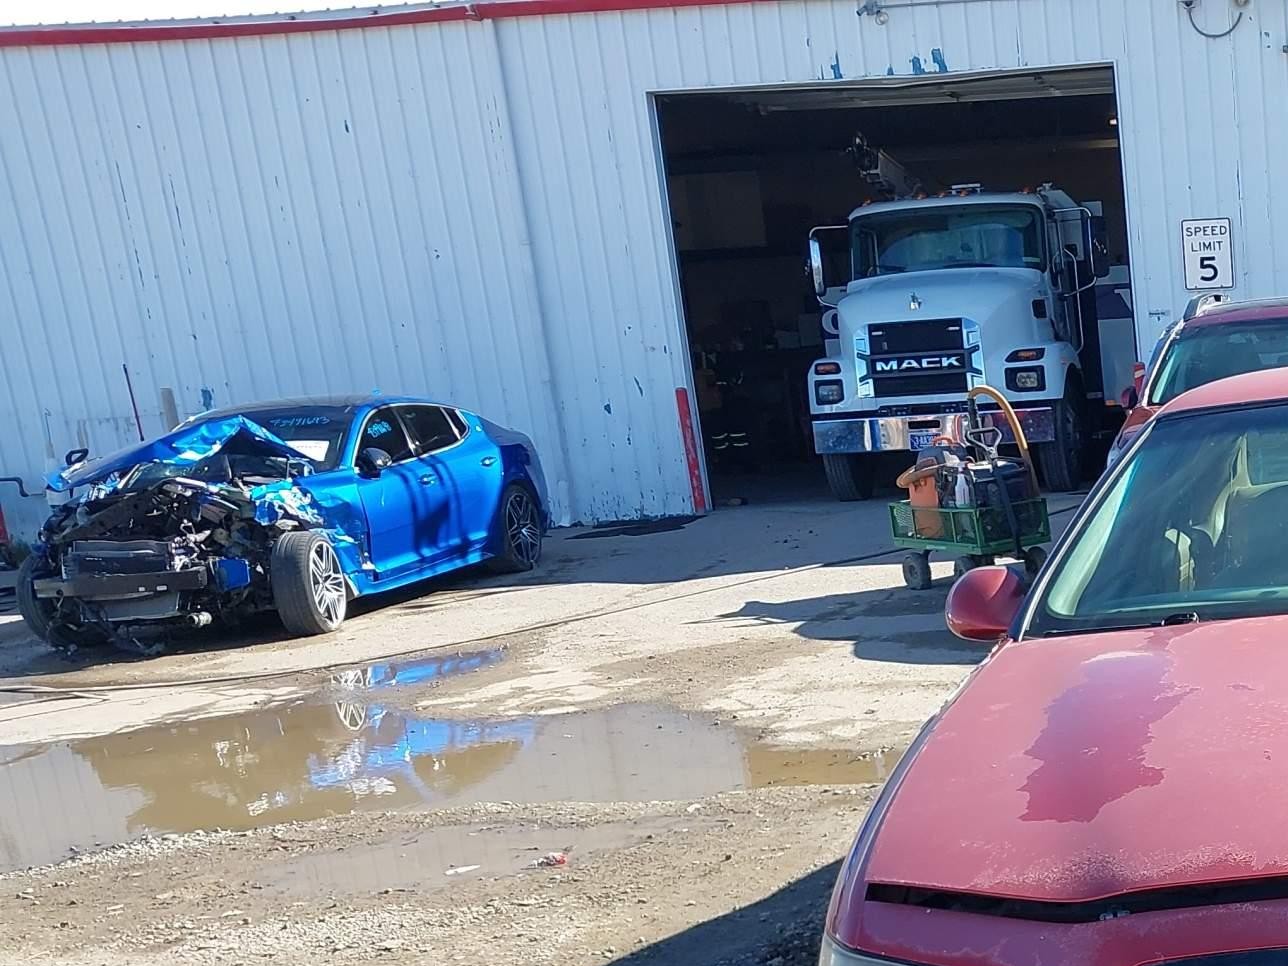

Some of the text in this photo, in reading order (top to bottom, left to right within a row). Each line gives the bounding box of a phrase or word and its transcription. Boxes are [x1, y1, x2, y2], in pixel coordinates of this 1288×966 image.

[1185, 225, 1228, 237] SPEED
[1191, 240, 1224, 252] LIMIT
[1199, 256, 1219, 282] 5
[875, 355, 961, 372] MACK
